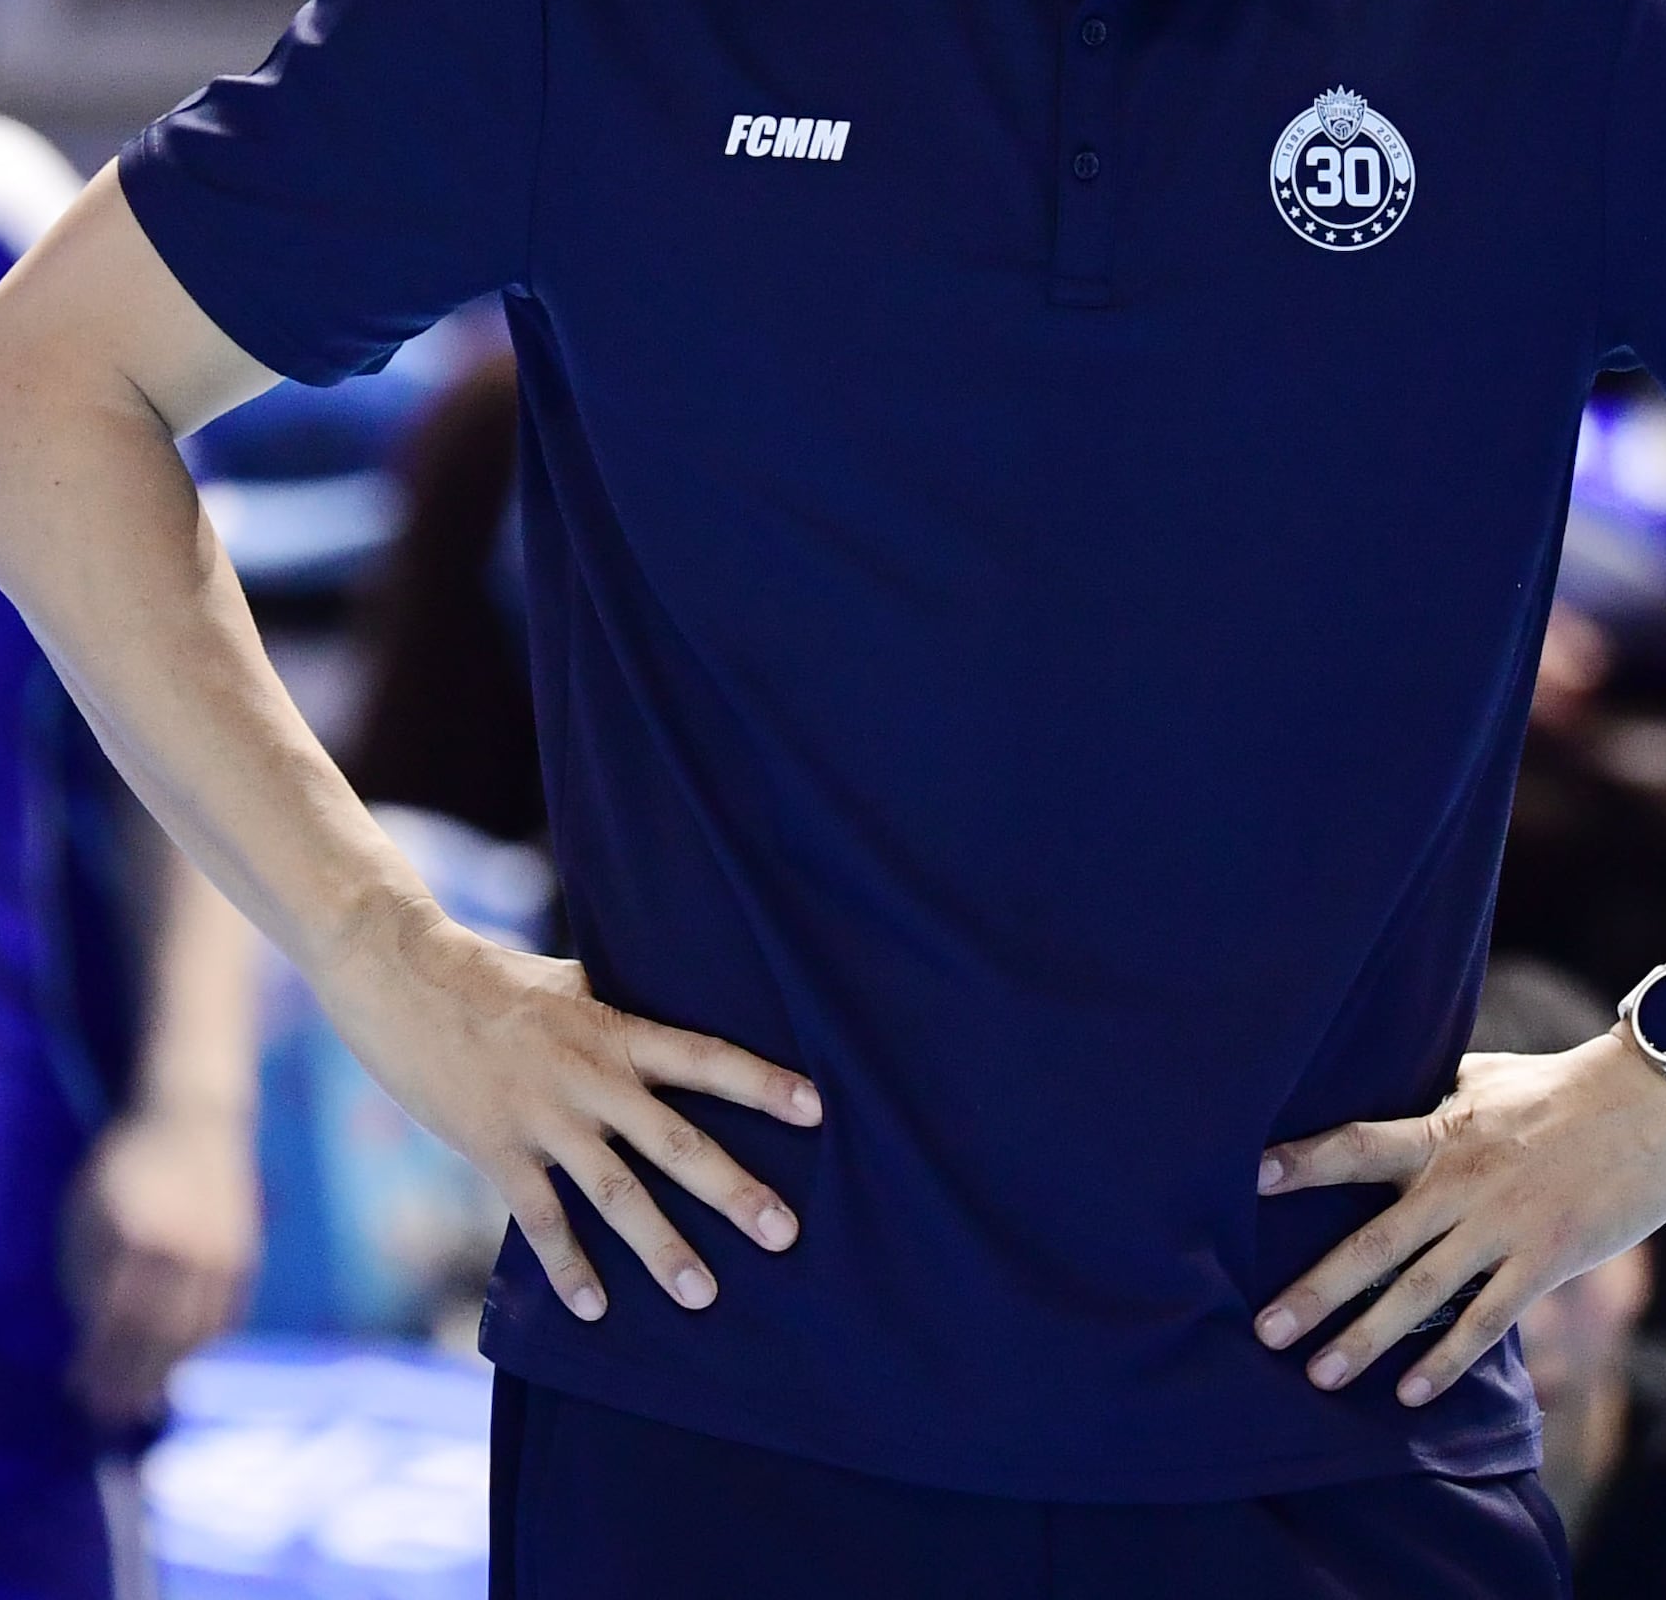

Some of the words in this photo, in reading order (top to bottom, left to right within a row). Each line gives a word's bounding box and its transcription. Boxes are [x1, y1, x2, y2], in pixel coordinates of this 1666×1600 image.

[724, 114, 851, 161] FCMM
[1283, 127, 1305, 158] 1995
[1377, 127, 1402, 160] 2025
[1305, 146, 1381, 207] 30
